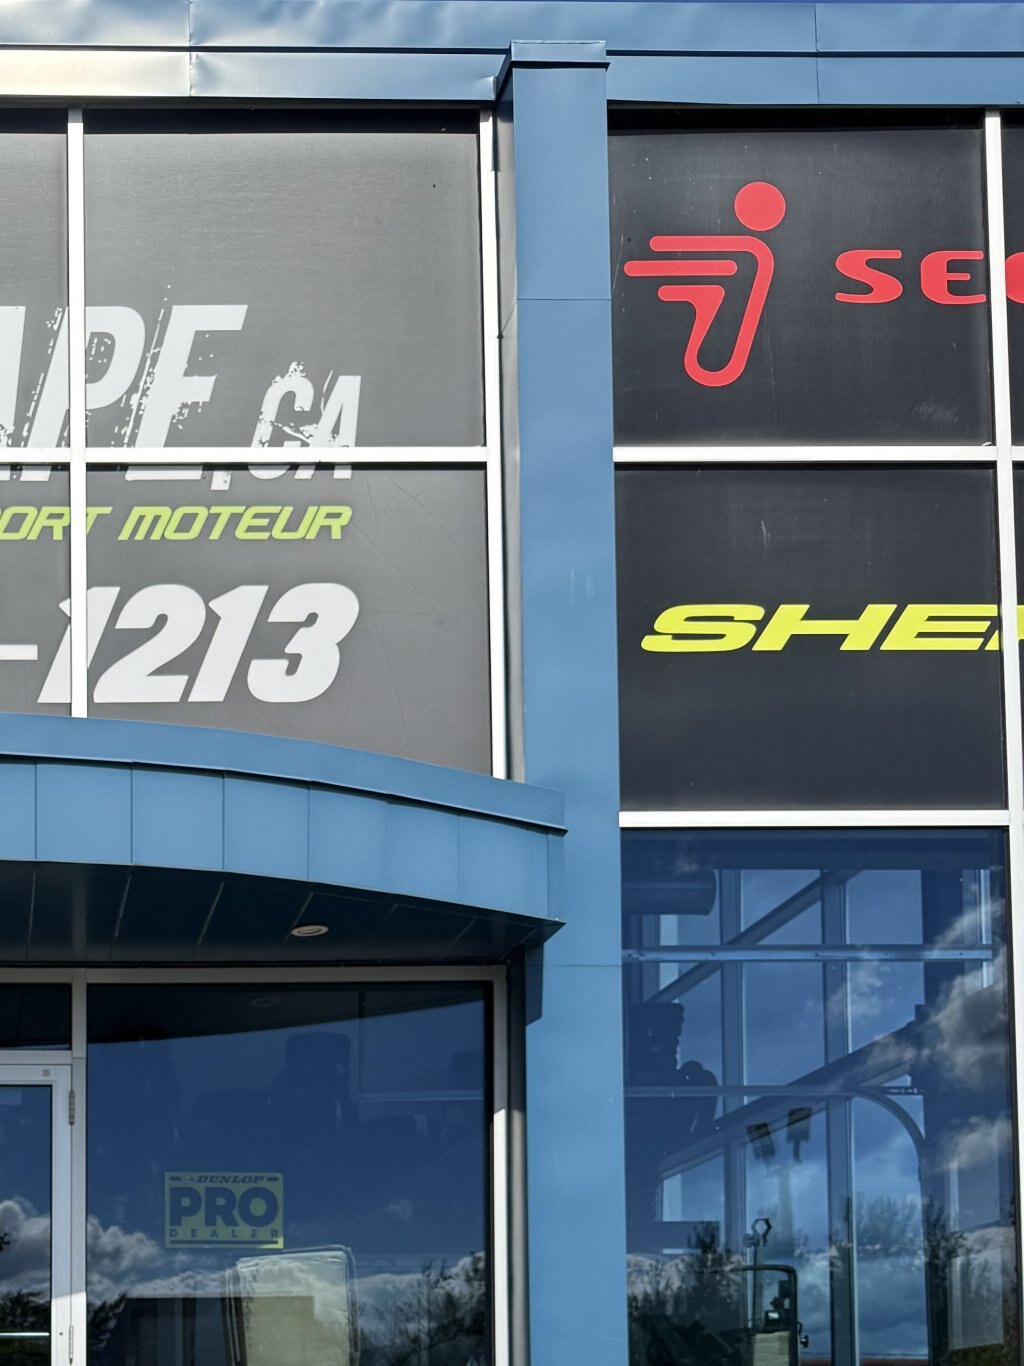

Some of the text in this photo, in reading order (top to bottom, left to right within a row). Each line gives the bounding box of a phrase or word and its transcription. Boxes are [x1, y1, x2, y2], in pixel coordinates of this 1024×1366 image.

[834, 249, 1024, 305] SE
[117, 504, 353, 542] MOTEUR
[196, 1175, 265, 1184] DUNLOP
[169, 1186, 279, 1228] PRO
[169, 1228, 279, 1239] DEALER
